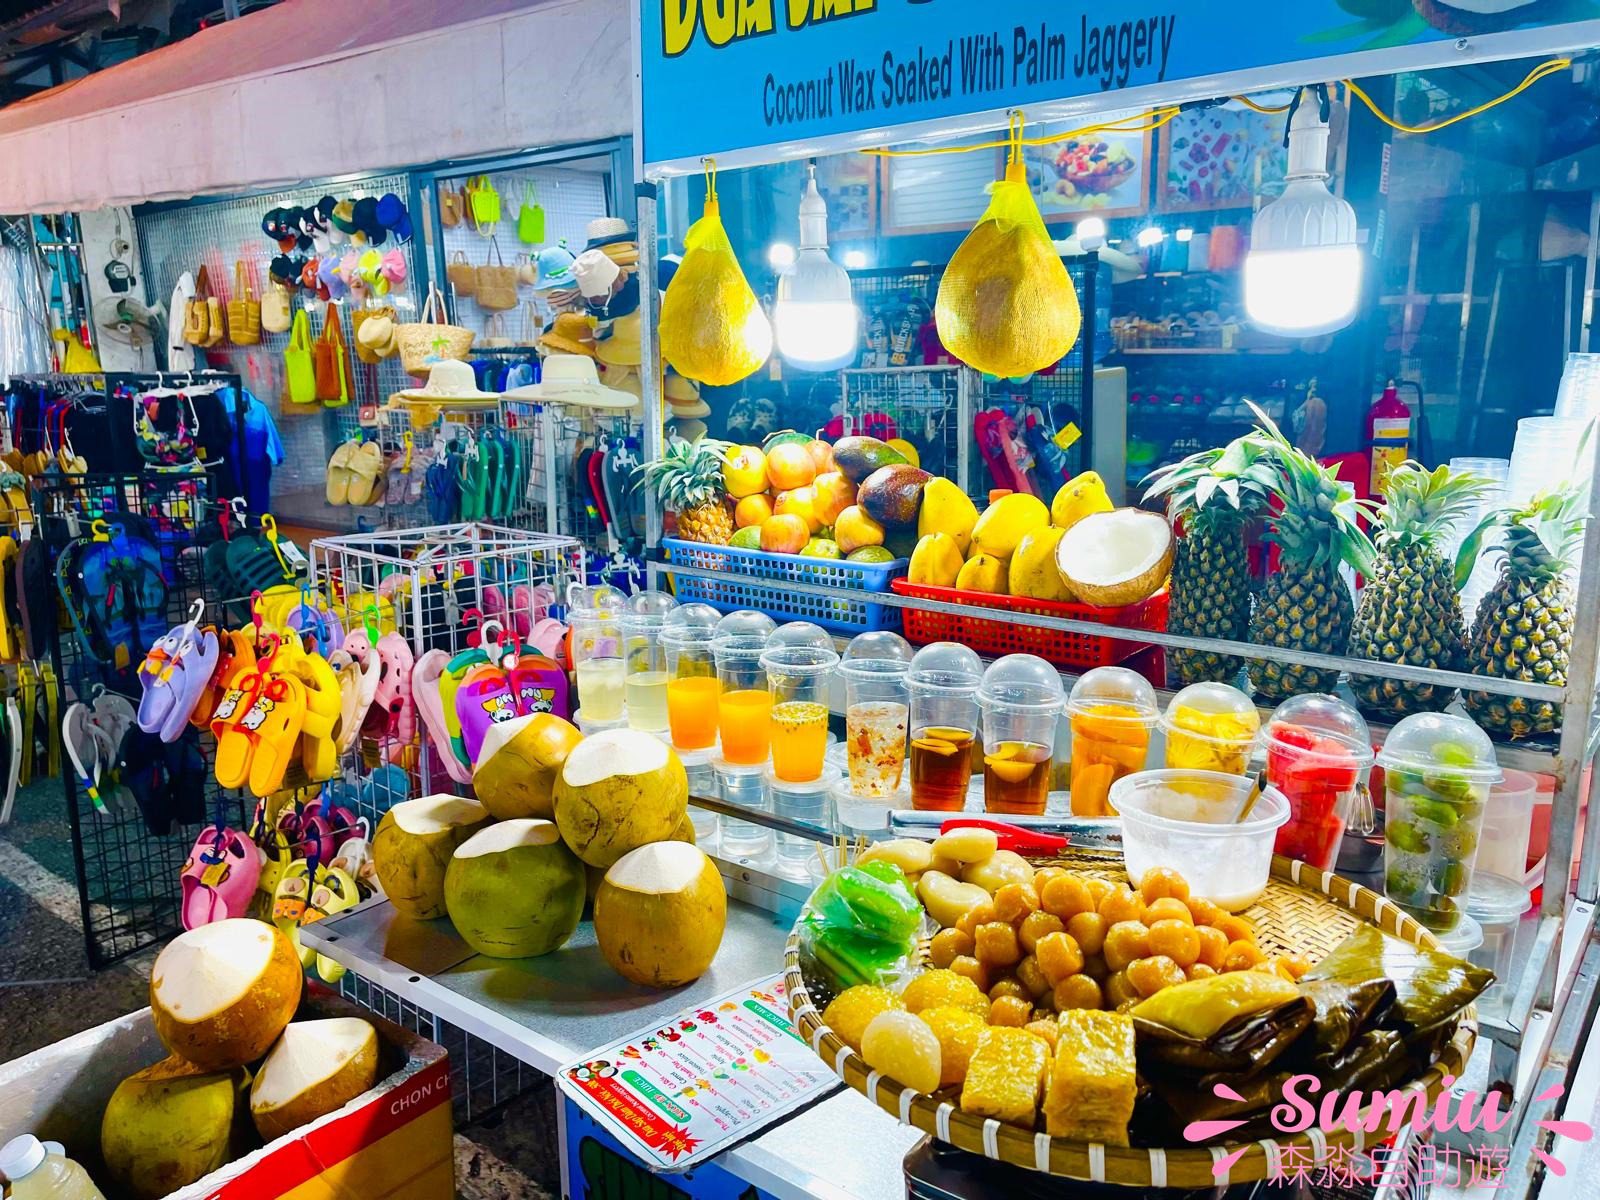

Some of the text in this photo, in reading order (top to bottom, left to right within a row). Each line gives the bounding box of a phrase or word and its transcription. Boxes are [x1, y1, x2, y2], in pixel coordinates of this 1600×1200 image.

[763, 15, 1176, 127] Coconut Wax Soaked With Palm Jaggery
[391, 1083, 432, 1115] CHON
[630, 1077, 655, 1093] JUICE
